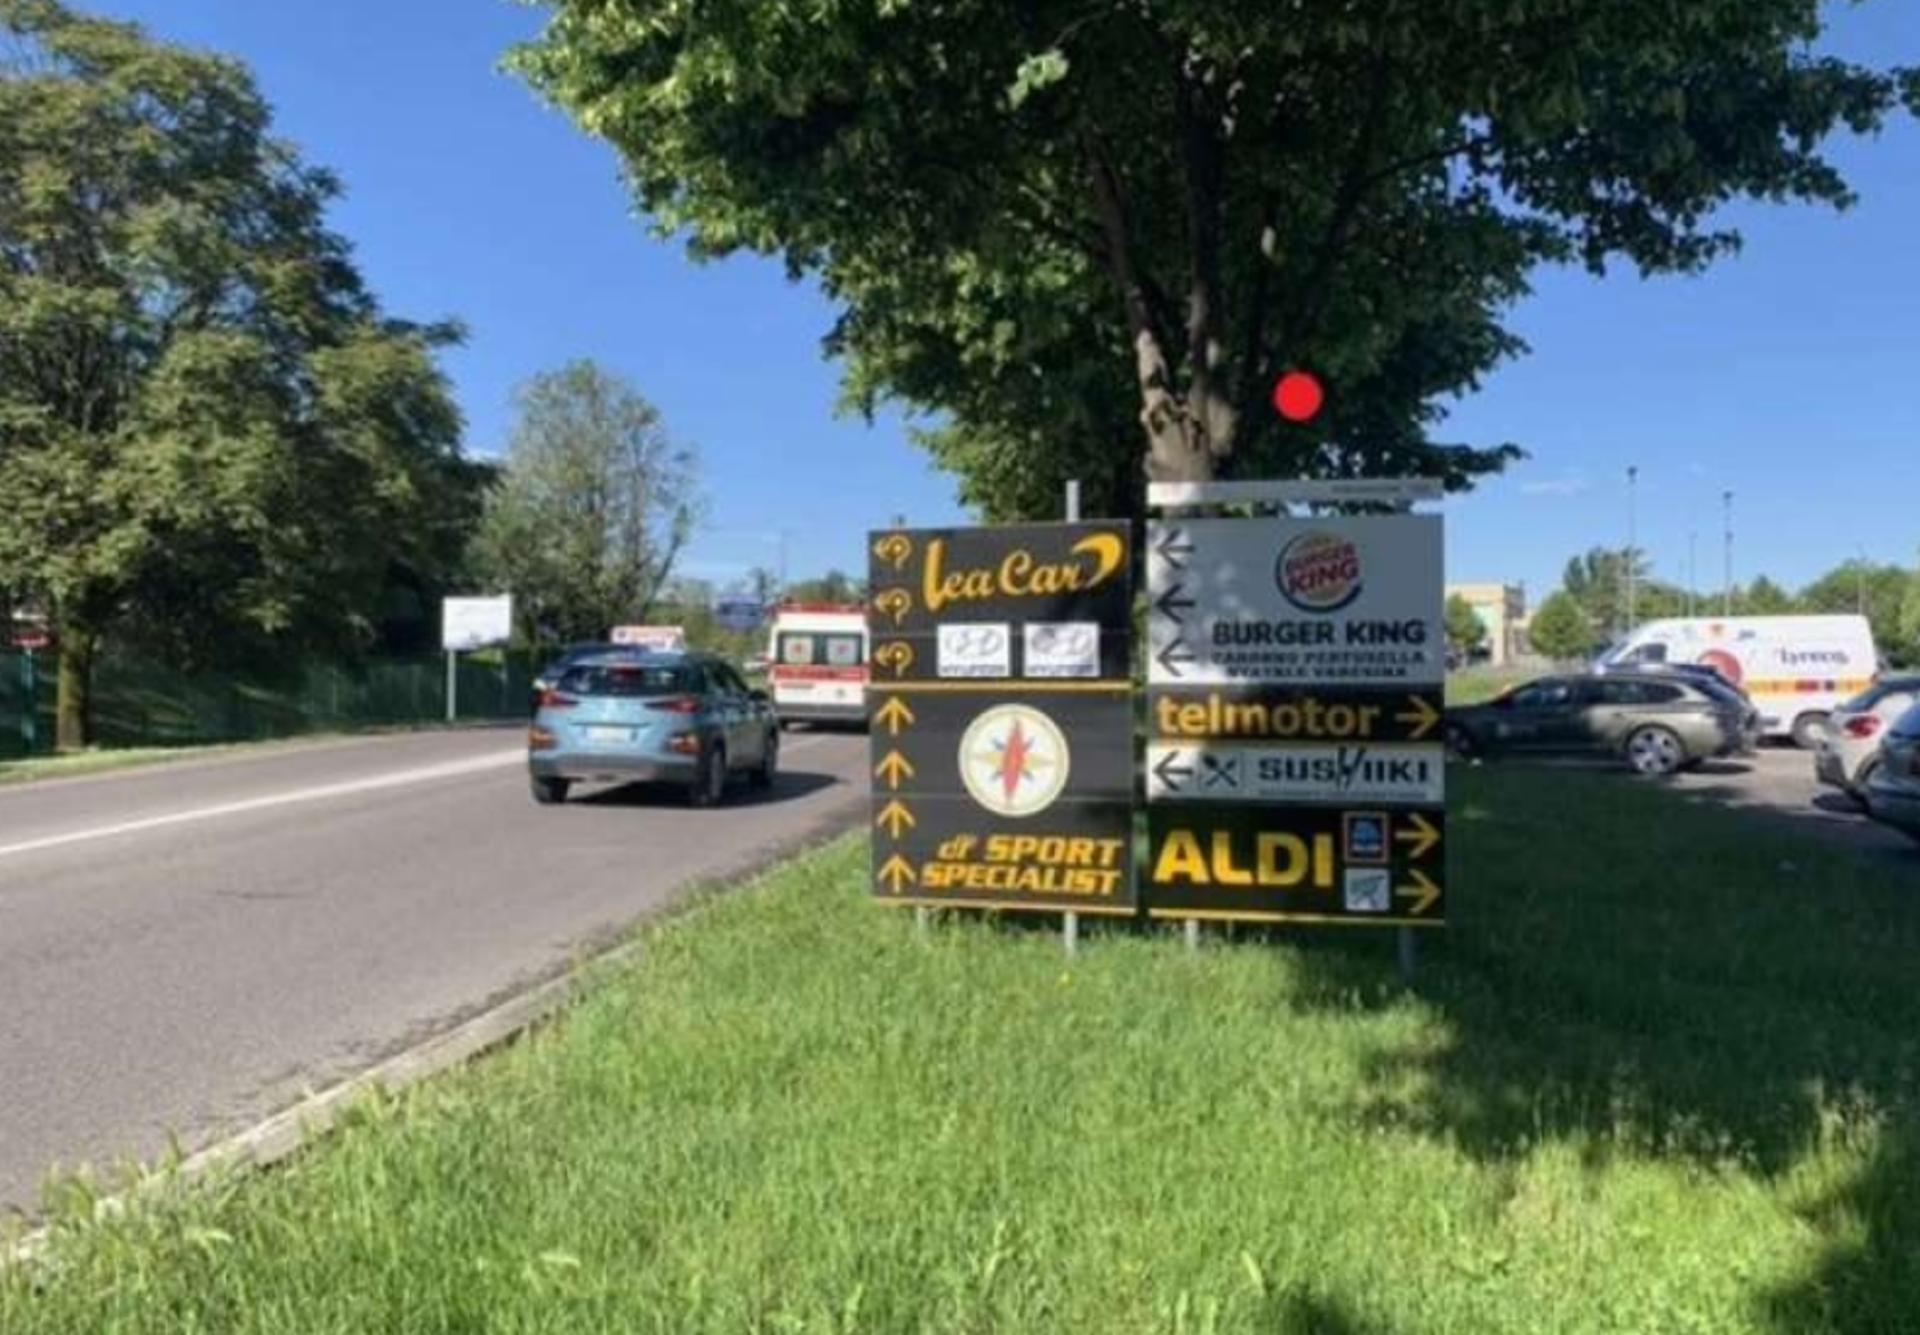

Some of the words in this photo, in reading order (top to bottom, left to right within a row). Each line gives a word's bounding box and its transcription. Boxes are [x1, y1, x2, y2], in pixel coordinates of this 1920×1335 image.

[1212, 619, 1335, 645] BURGER
[1346, 620, 1426, 645] KING
[1157, 695, 1382, 736] telmotor
[985, 834, 1123, 865] SPORT
[1153, 830, 1334, 887] ALDI
[920, 863, 1122, 895] SPECIALIST
